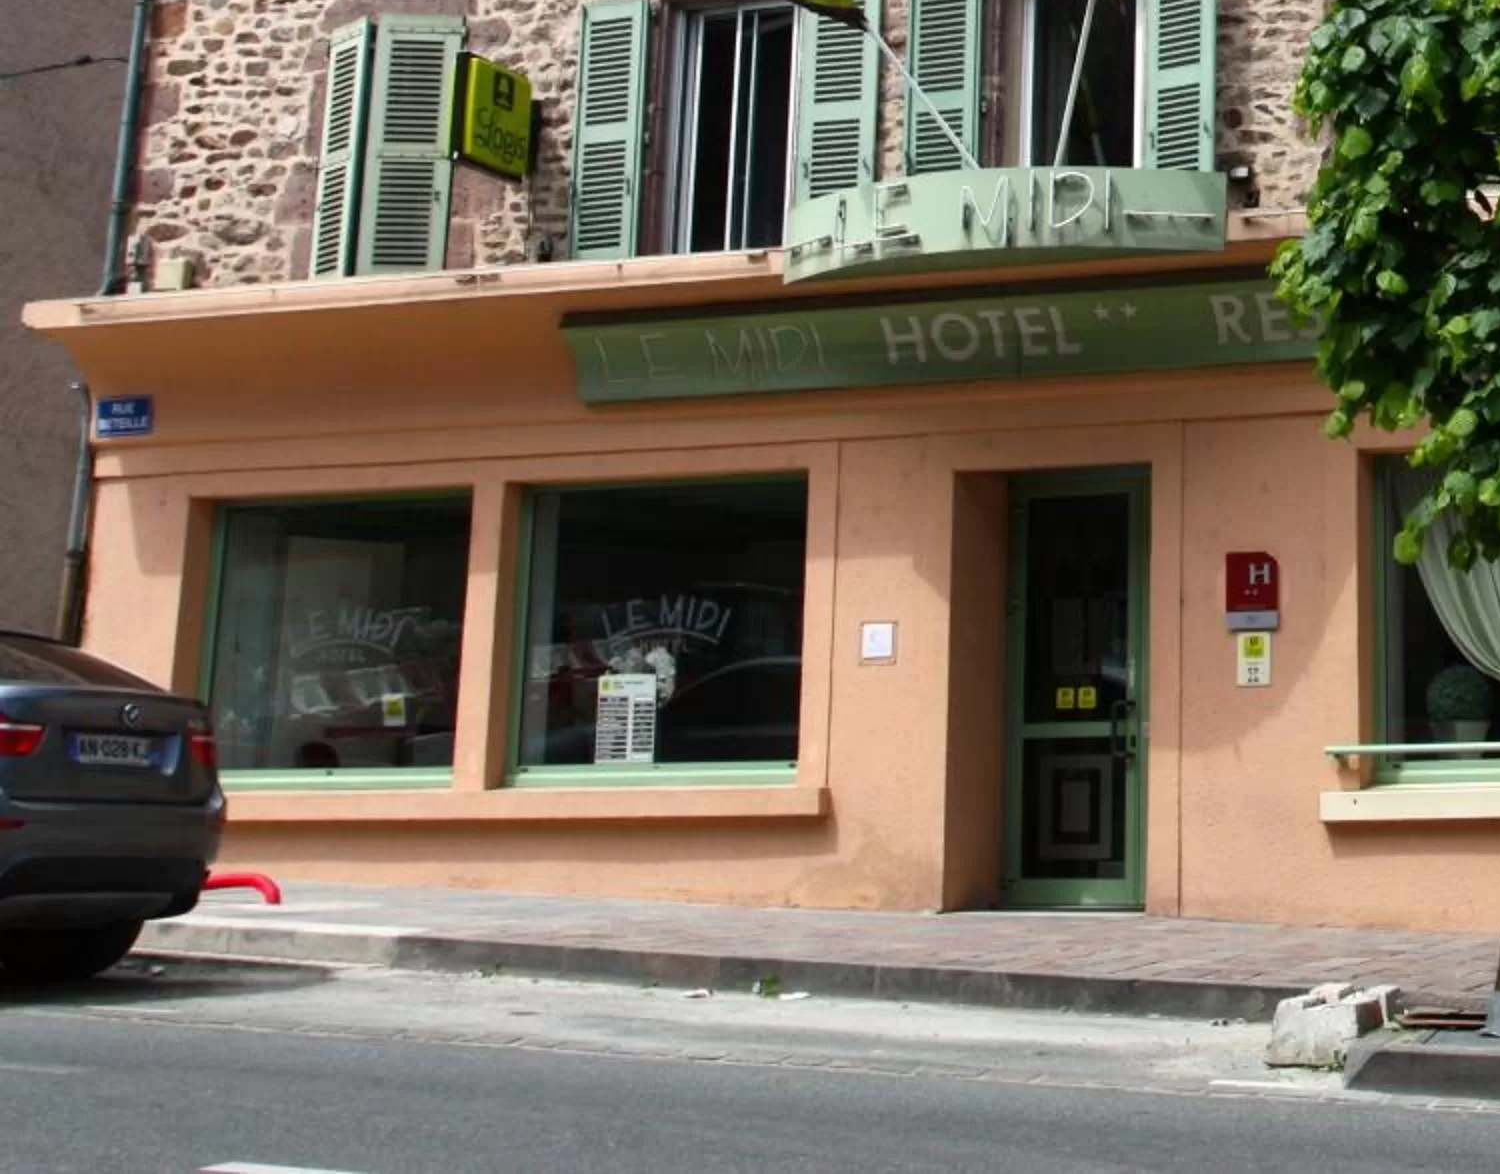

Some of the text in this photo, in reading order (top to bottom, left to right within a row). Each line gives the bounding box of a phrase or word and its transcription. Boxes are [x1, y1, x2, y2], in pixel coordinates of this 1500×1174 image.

[834, 169, 1113, 251] LE MIDI
[593, 306, 1084, 384] LE MIDI HOTEL
[1248, 562, 1271, 585] H
[658, 593, 733, 639] MIDI
